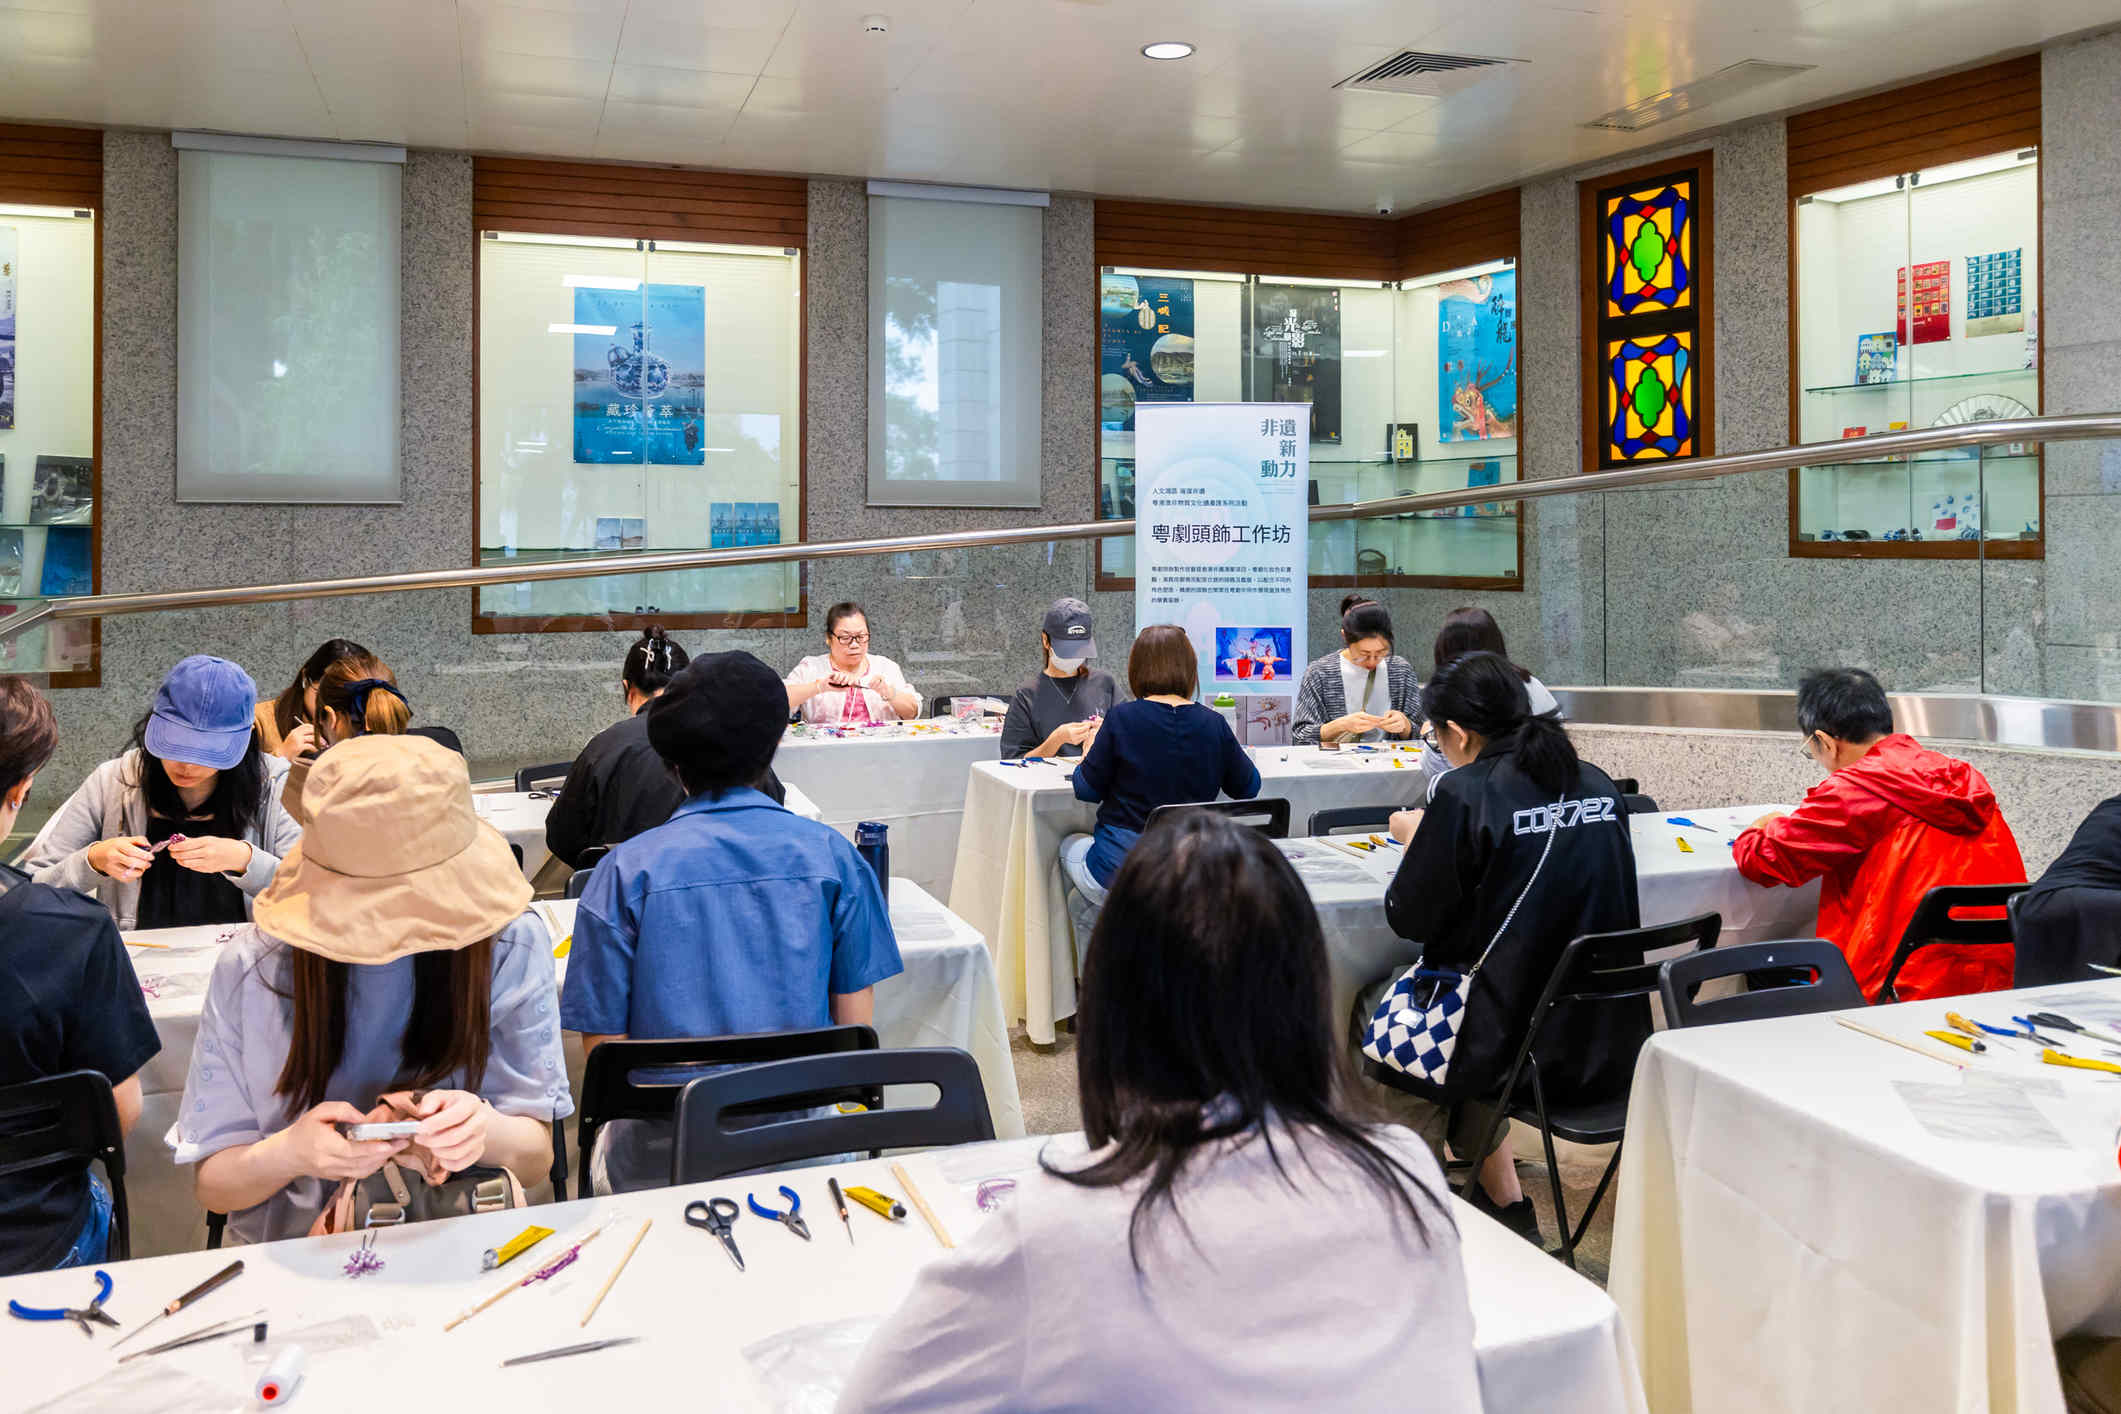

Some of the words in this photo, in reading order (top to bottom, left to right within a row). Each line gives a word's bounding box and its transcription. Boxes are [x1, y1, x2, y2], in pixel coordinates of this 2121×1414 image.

[1260, 418, 1297, 437] 非遺
[1279, 440, 1297, 457] 新
[1260, 460, 1297, 478] 動力
[1151, 523, 1291, 545] 粵劇頭飾工作坊
